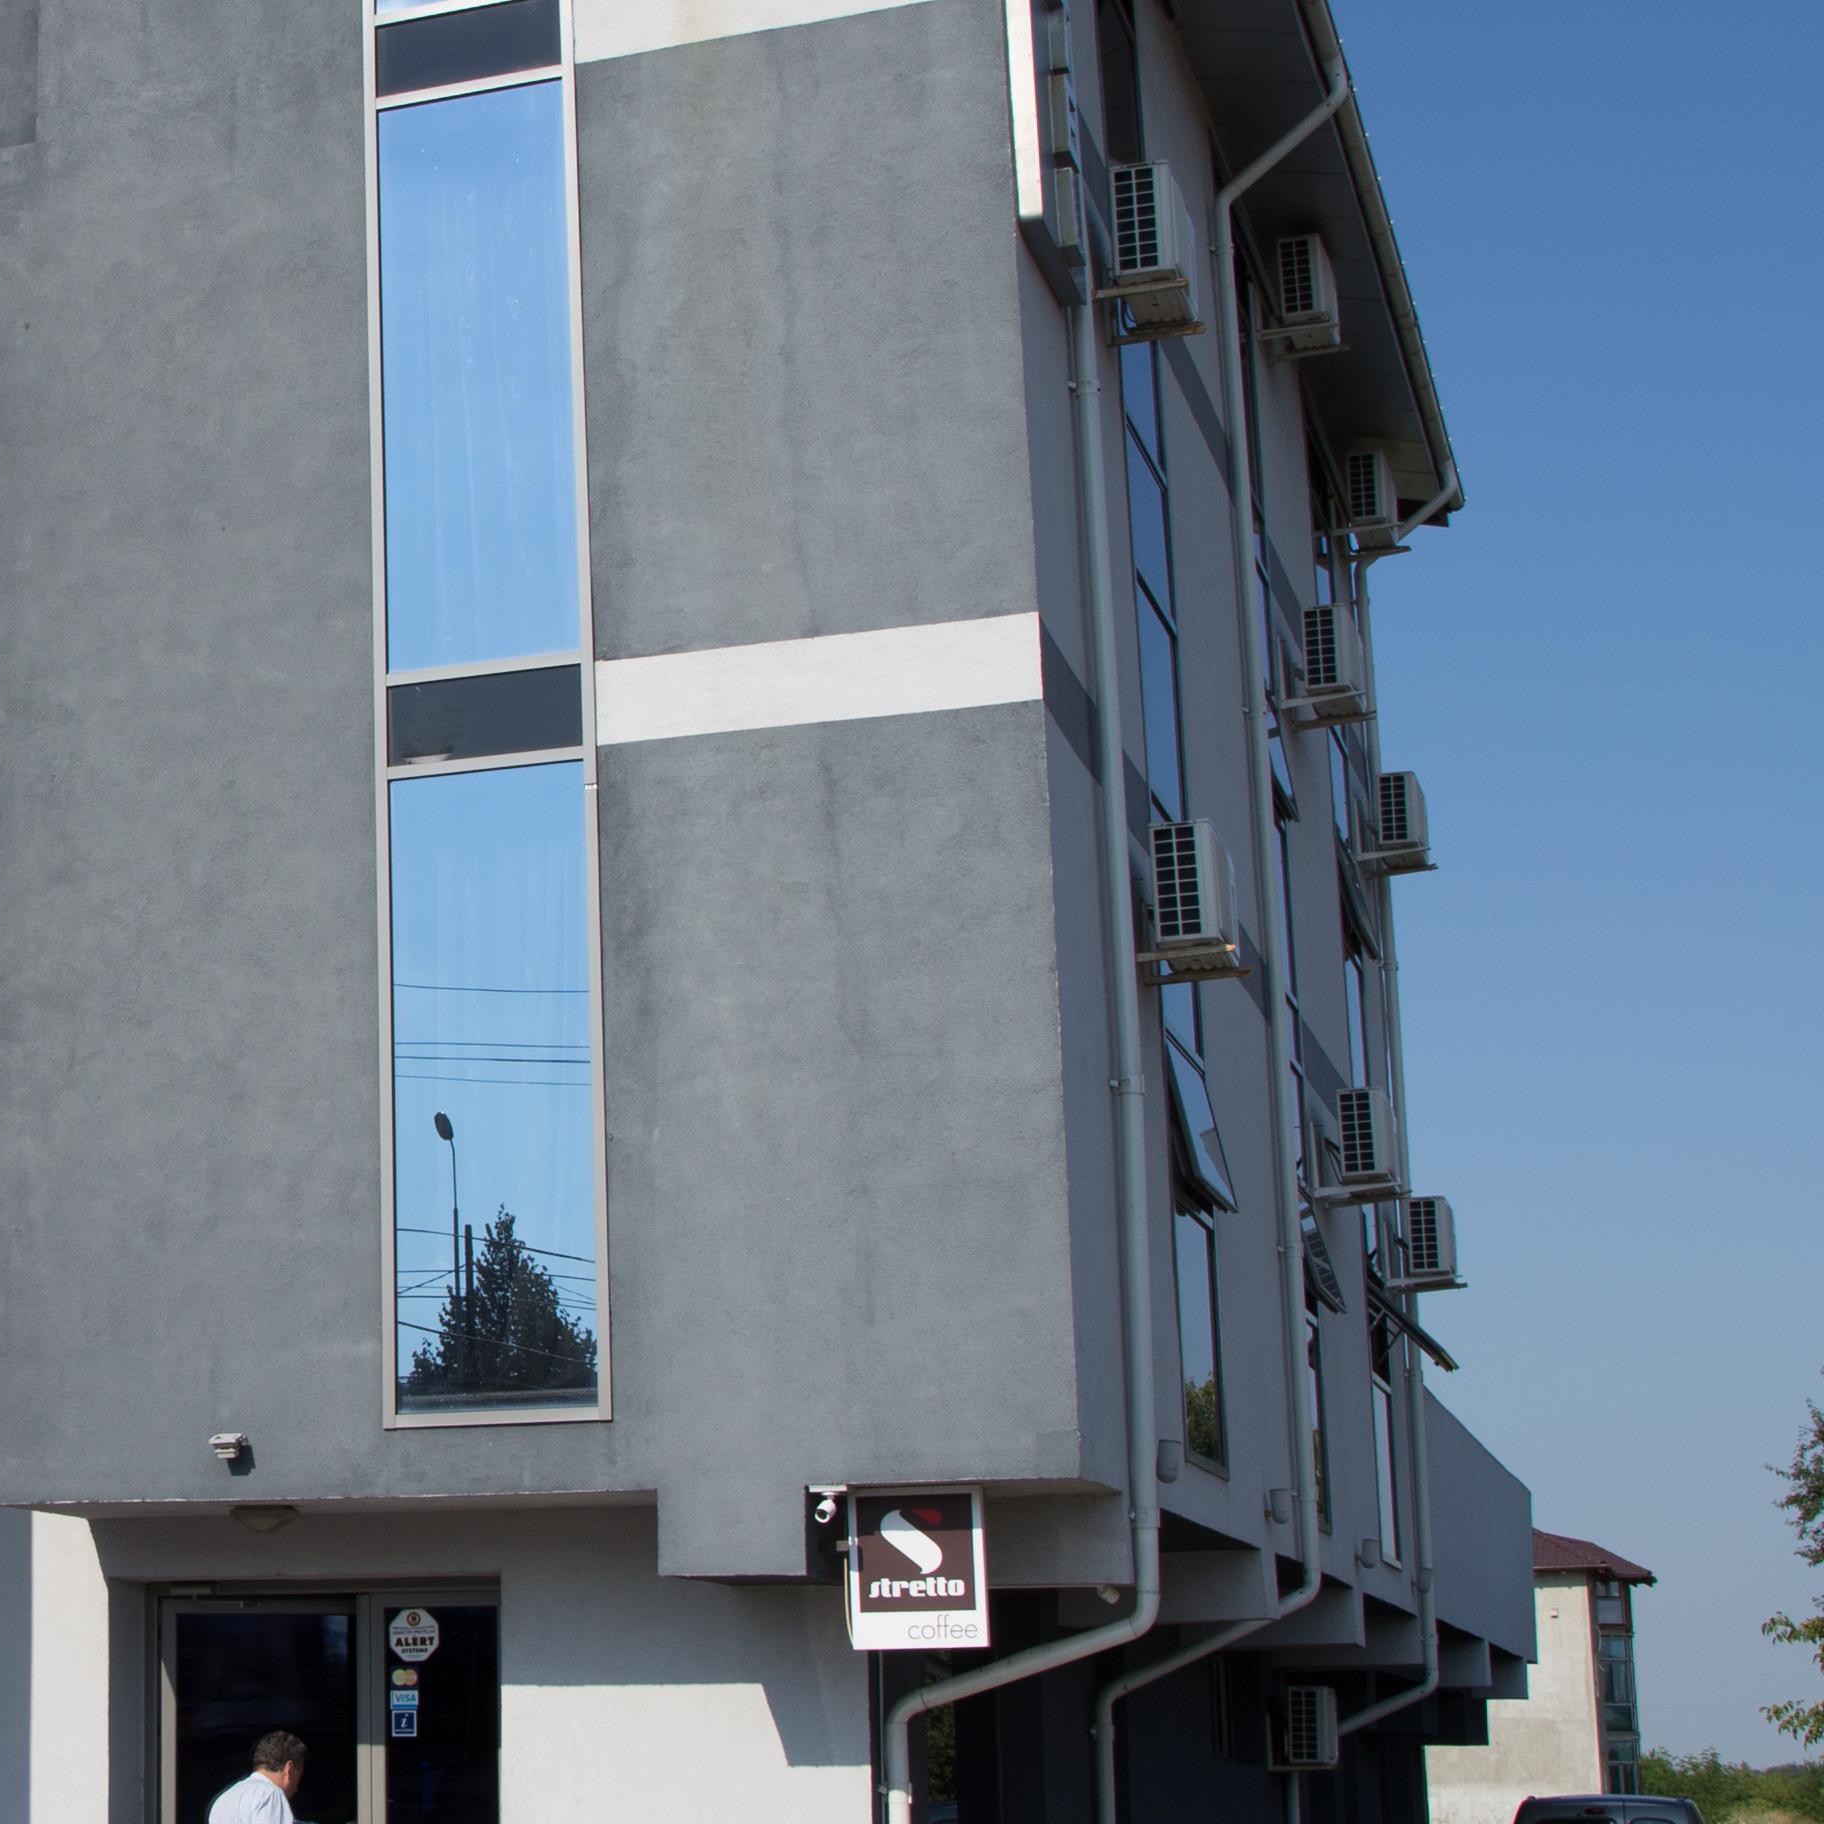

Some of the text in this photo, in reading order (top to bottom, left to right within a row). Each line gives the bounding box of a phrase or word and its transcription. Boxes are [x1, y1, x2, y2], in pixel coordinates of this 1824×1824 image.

[868, 1576, 966, 1598] stretto
[908, 1614, 978, 1640] coffee
[395, 1636, 435, 1647] ALERT
[395, 1694, 416, 1702] VISA
